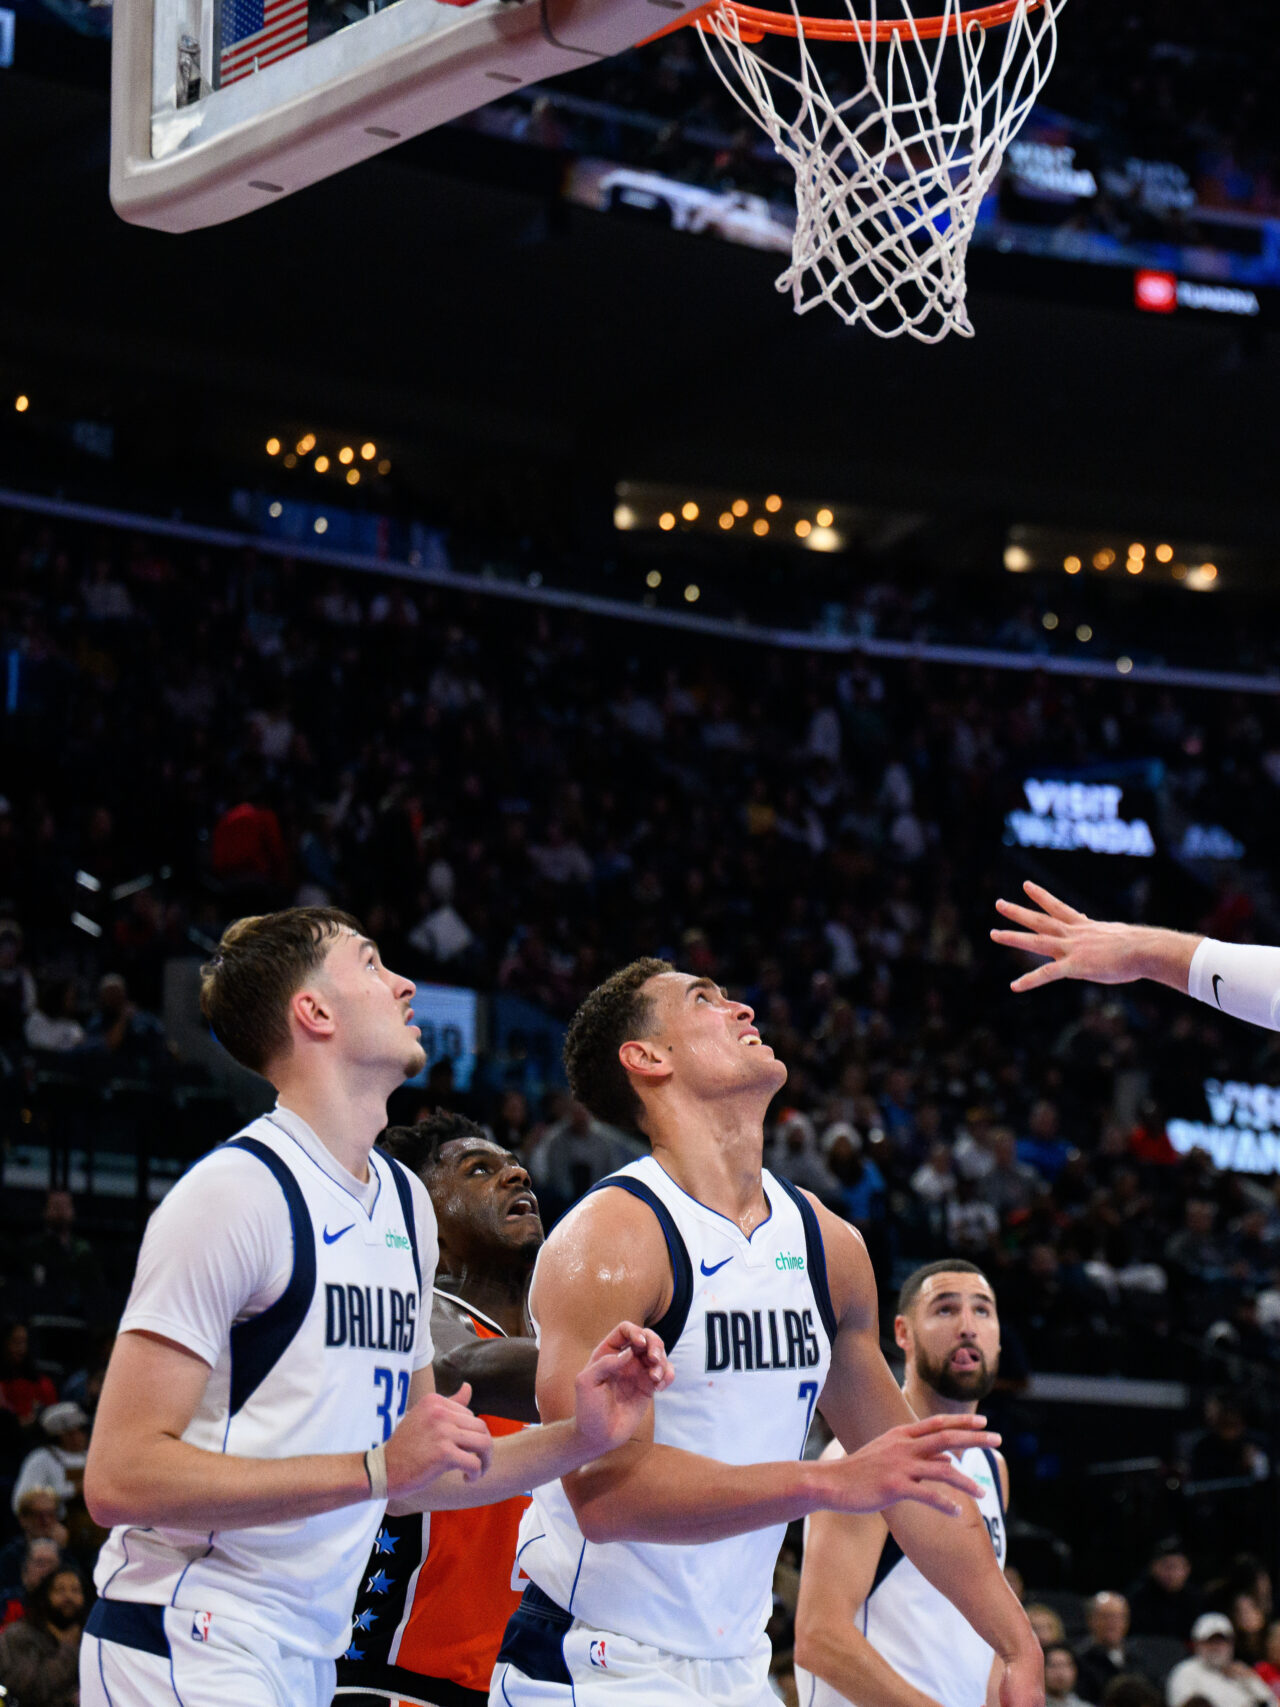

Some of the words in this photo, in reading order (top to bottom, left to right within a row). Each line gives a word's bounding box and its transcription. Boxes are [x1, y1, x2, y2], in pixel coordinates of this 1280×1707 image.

[385, 1227, 411, 1250] chime
[775, 1251, 805, 1271] chime
[325, 1282, 417, 1353] DALLAS
[705, 1309, 820, 1373] DALLAS
[798, 1380, 819, 1461] 7
